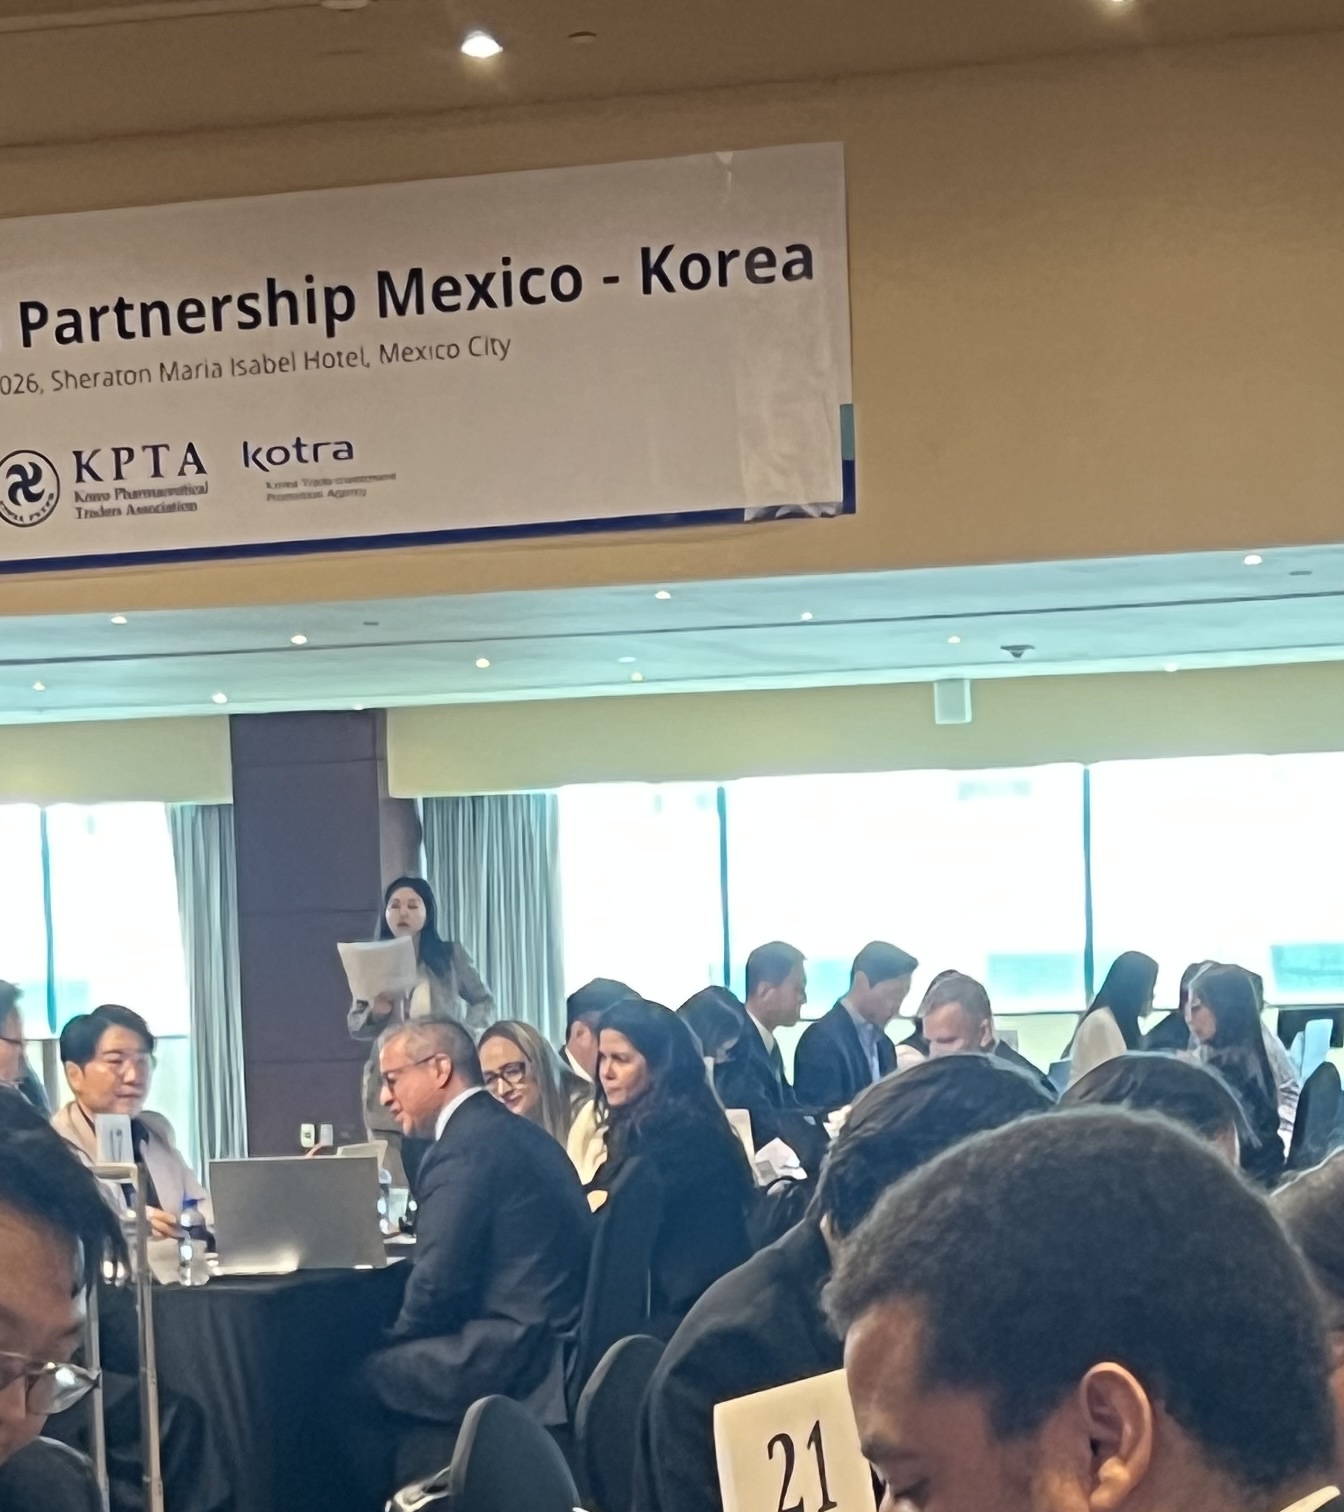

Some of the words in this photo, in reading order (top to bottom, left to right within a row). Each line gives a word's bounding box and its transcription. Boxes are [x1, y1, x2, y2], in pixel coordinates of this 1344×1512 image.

[19, 273, 357, 348] Partnership
[376, 256, 584, 318] Mexico
[602, 275, 620, 285] -
[639, 243, 814, 296] Korea
[51, 366, 152, 392] Sheraton
[159, 360, 223, 382] Maria
[230, 351, 297, 377] Isabel
[304, 346, 371, 370] Hotel,
[379, 342, 460, 364] Mexico
[468, 335, 512, 361] City
[72, 441, 208, 484] KPTA
[242, 436, 354, 472] kotra
